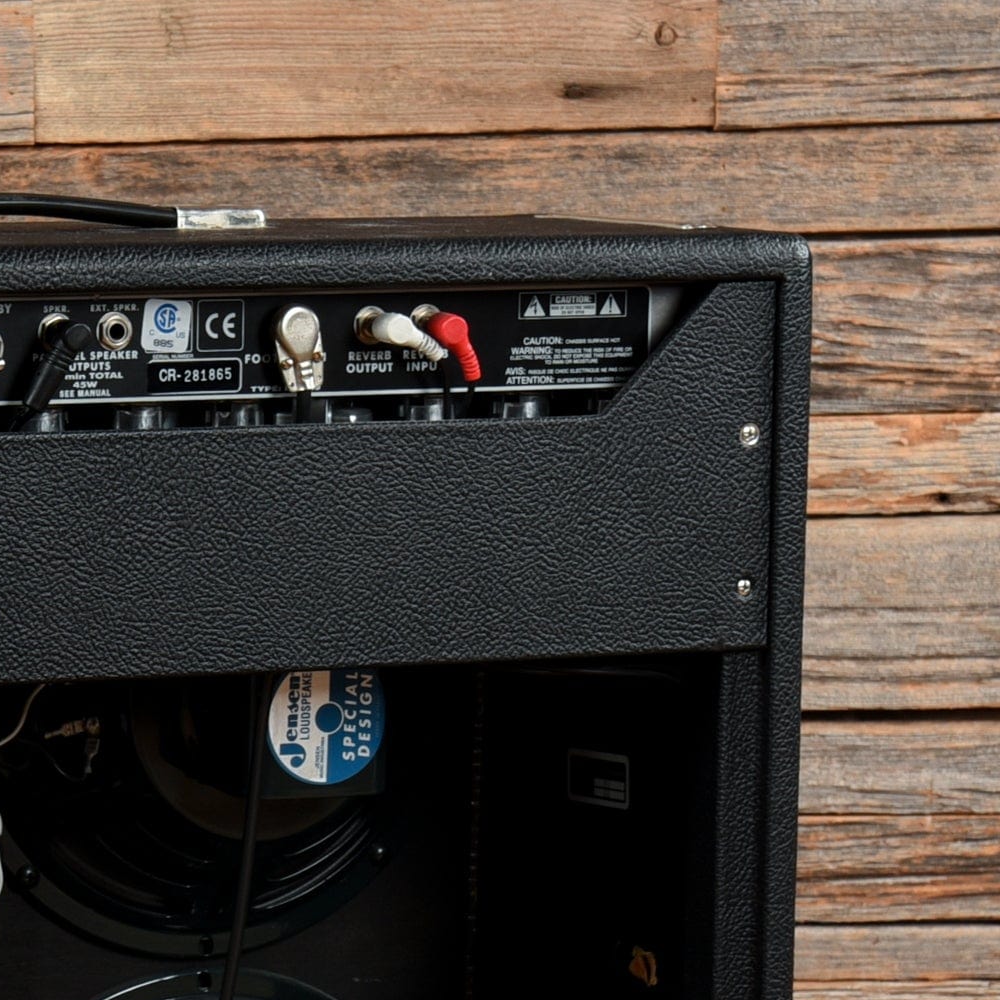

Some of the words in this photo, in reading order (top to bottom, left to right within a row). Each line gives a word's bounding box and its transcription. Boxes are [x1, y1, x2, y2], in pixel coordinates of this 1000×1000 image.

[555, 295, 593, 304] CAUTION:
[43, 305, 70, 313] SPKR.
[90, 304, 110, 313] EXT.
[113, 303, 140, 312] SPKR.
[205, 313, 236, 339] CE
[523, 336, 563, 346] CAUTION:
[90, 351, 138, 360] SPEAKER
[348, 350, 392, 361] REVERB
[403, 348, 449, 360] REVB
[511, 346, 553, 355] WARNING:
[69, 361, 111, 371] UTPUTS
[346, 362, 393, 373] OUTPUT
[64, 372, 86, 380] min
[89, 371, 124, 380] TOTAL
[159, 367, 232, 383] CR-281865
[505, 367, 526, 376] AVIS:
[72, 381, 98, 389] 45W
[505, 376, 555, 385] ATTENTION:
[59, 390, 76, 398] SEE
[77, 388, 111, 398] MANUAL
[300, 671, 312, 740] LOUDSPEAKE
[342, 672, 358, 761] SPECIAL
[357, 674, 373, 757] DESIGN
[280, 675, 306, 768] Jensen
